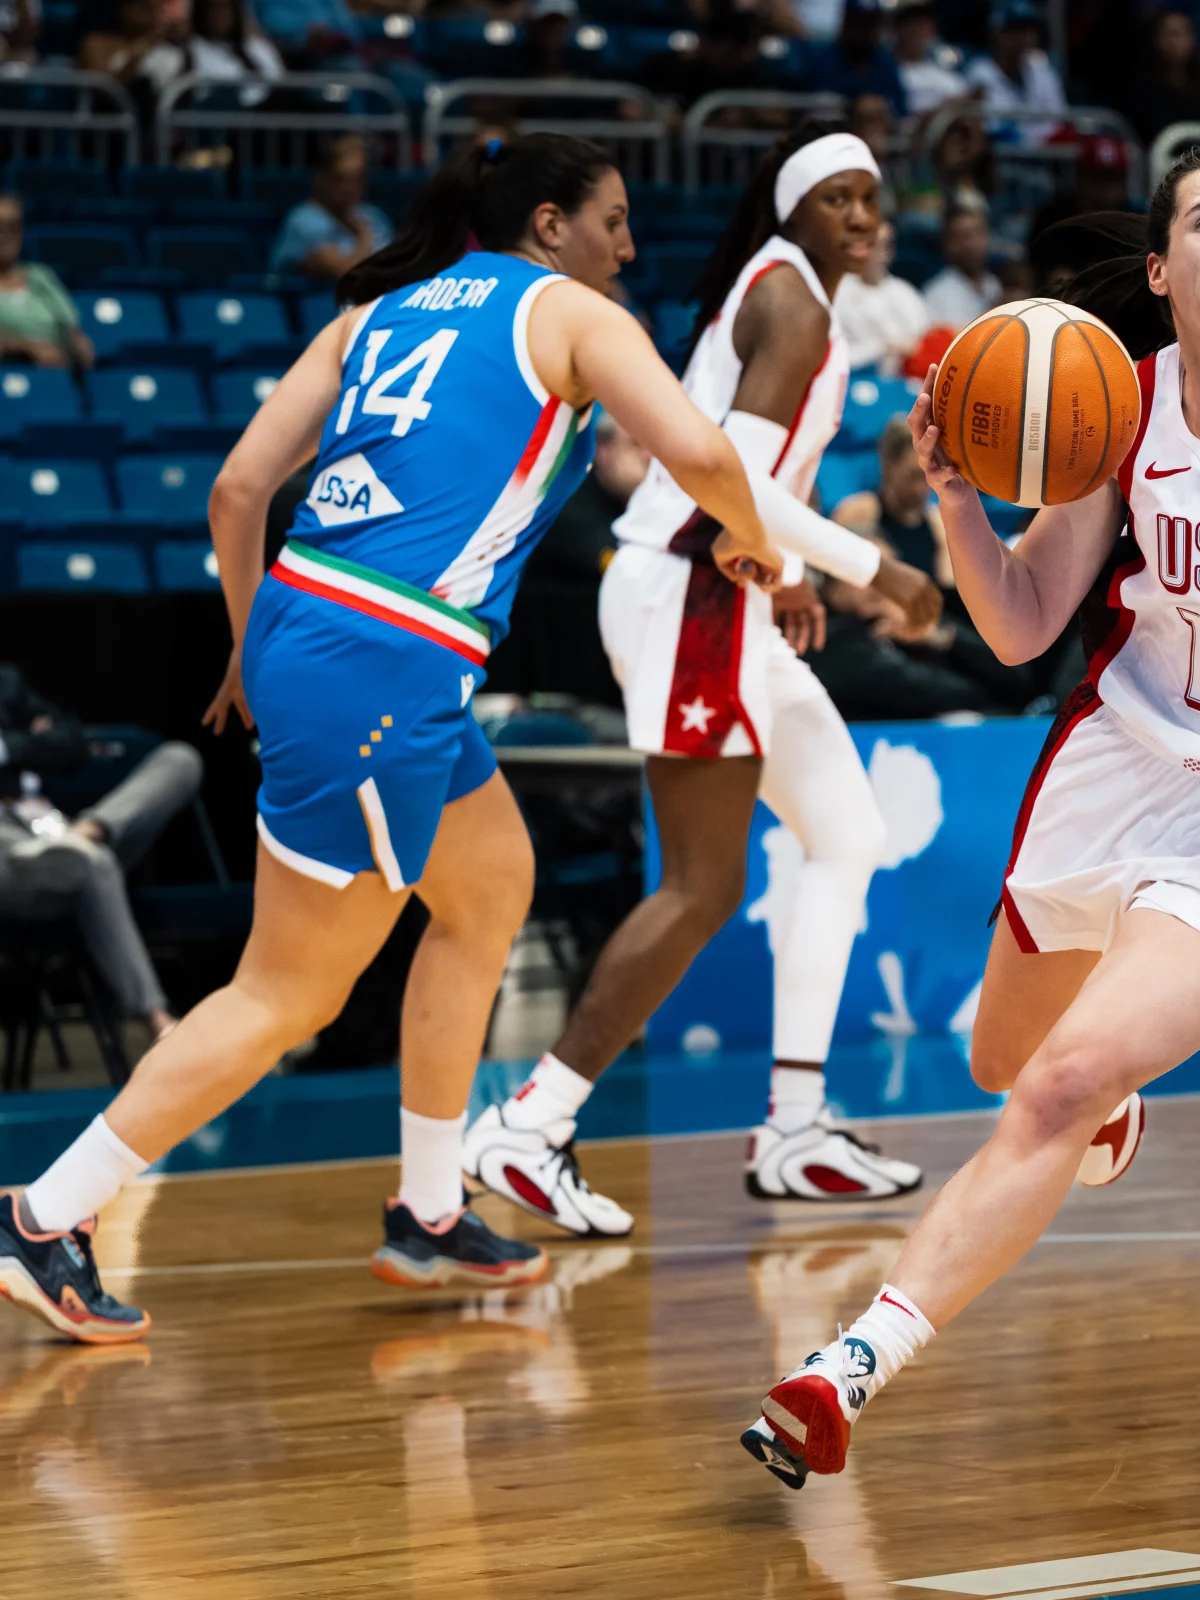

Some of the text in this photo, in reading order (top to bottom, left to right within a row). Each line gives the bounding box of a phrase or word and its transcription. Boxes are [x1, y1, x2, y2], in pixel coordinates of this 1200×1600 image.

[335, 328, 460, 437] 14
[1071, 391, 1079, 408] BALL
[971, 401, 991, 448] FIBA
[991, 405, 1002, 450] APPROVED
[1072, 409, 1080, 428] GAME
[1070, 430, 1079, 456] OFFICIAL
